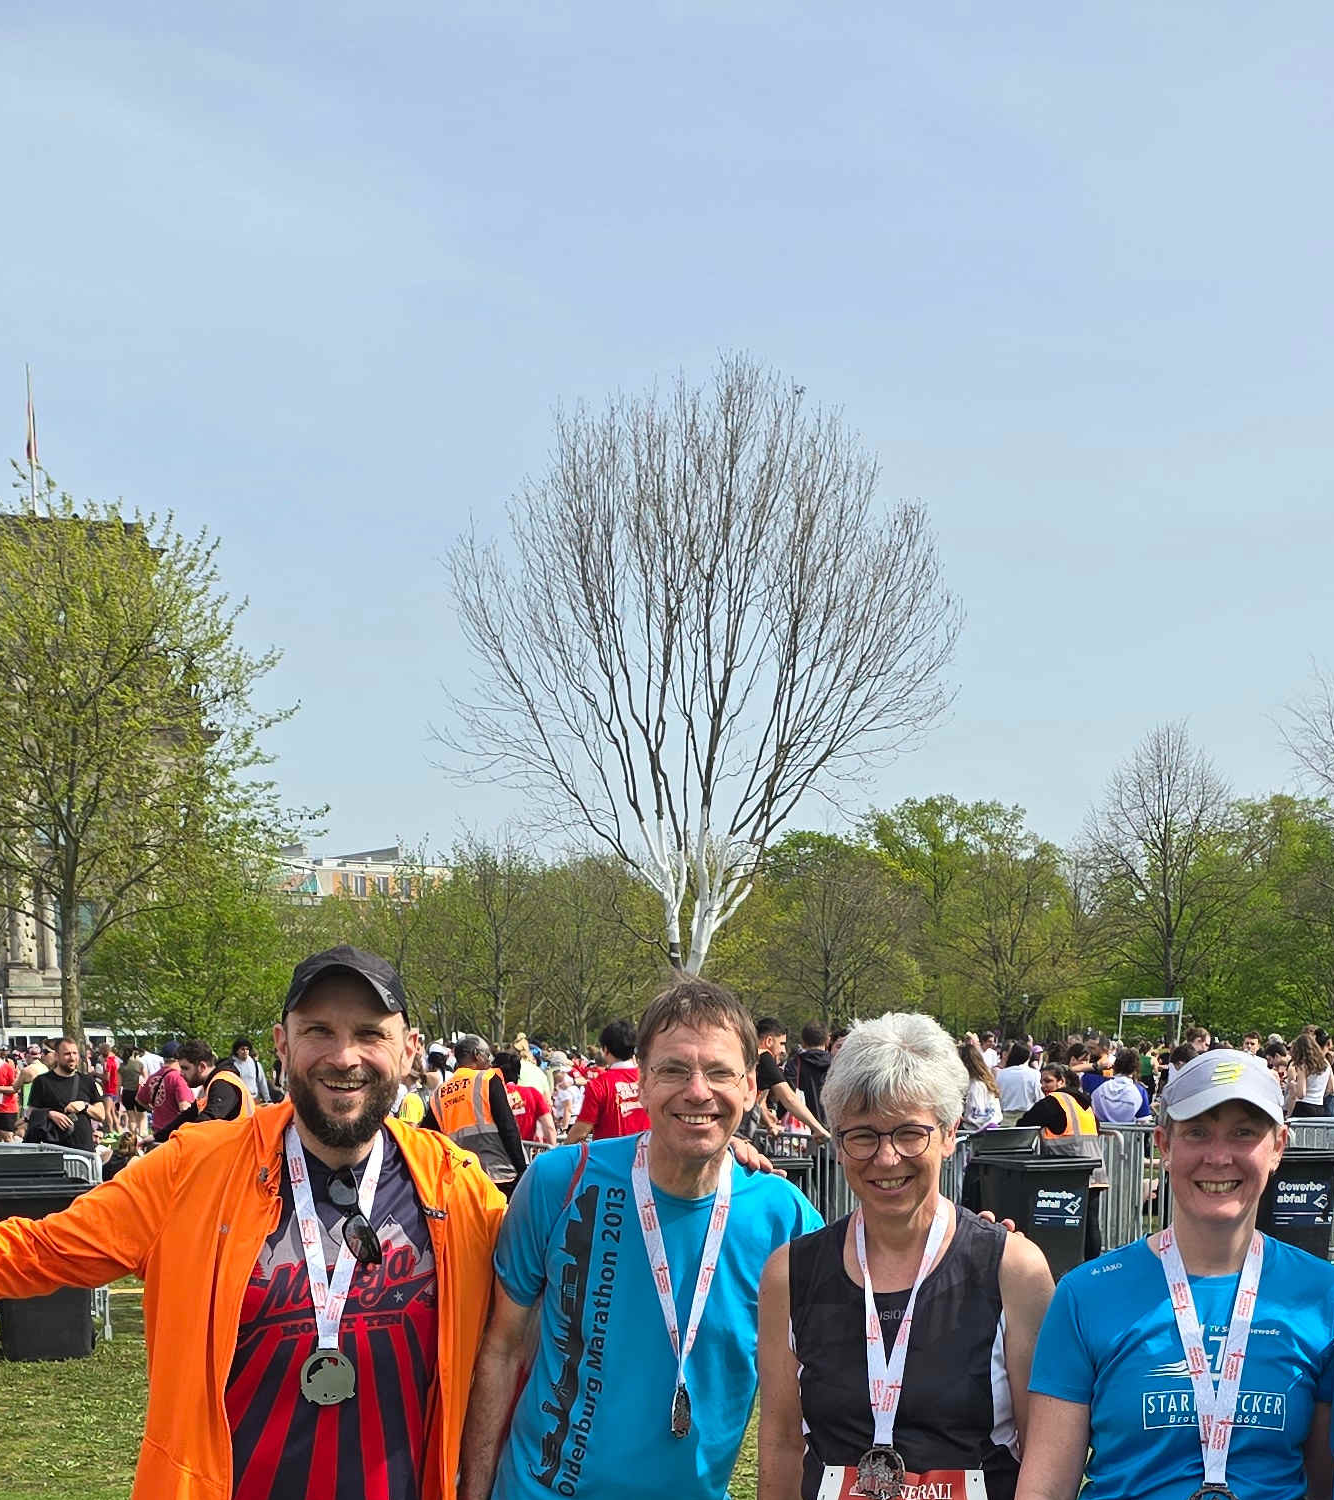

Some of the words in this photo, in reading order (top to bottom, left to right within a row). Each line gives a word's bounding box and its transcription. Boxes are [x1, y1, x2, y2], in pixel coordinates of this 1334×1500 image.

[602, 1187, 627, 1243] 2013
[1277, 1194, 1307, 1203] abfall
[587, 1250, 618, 1372] Marathon
[558, 1377, 603, 1497] Oldenburg
[899, 1482, 954, 1500] NERALI
